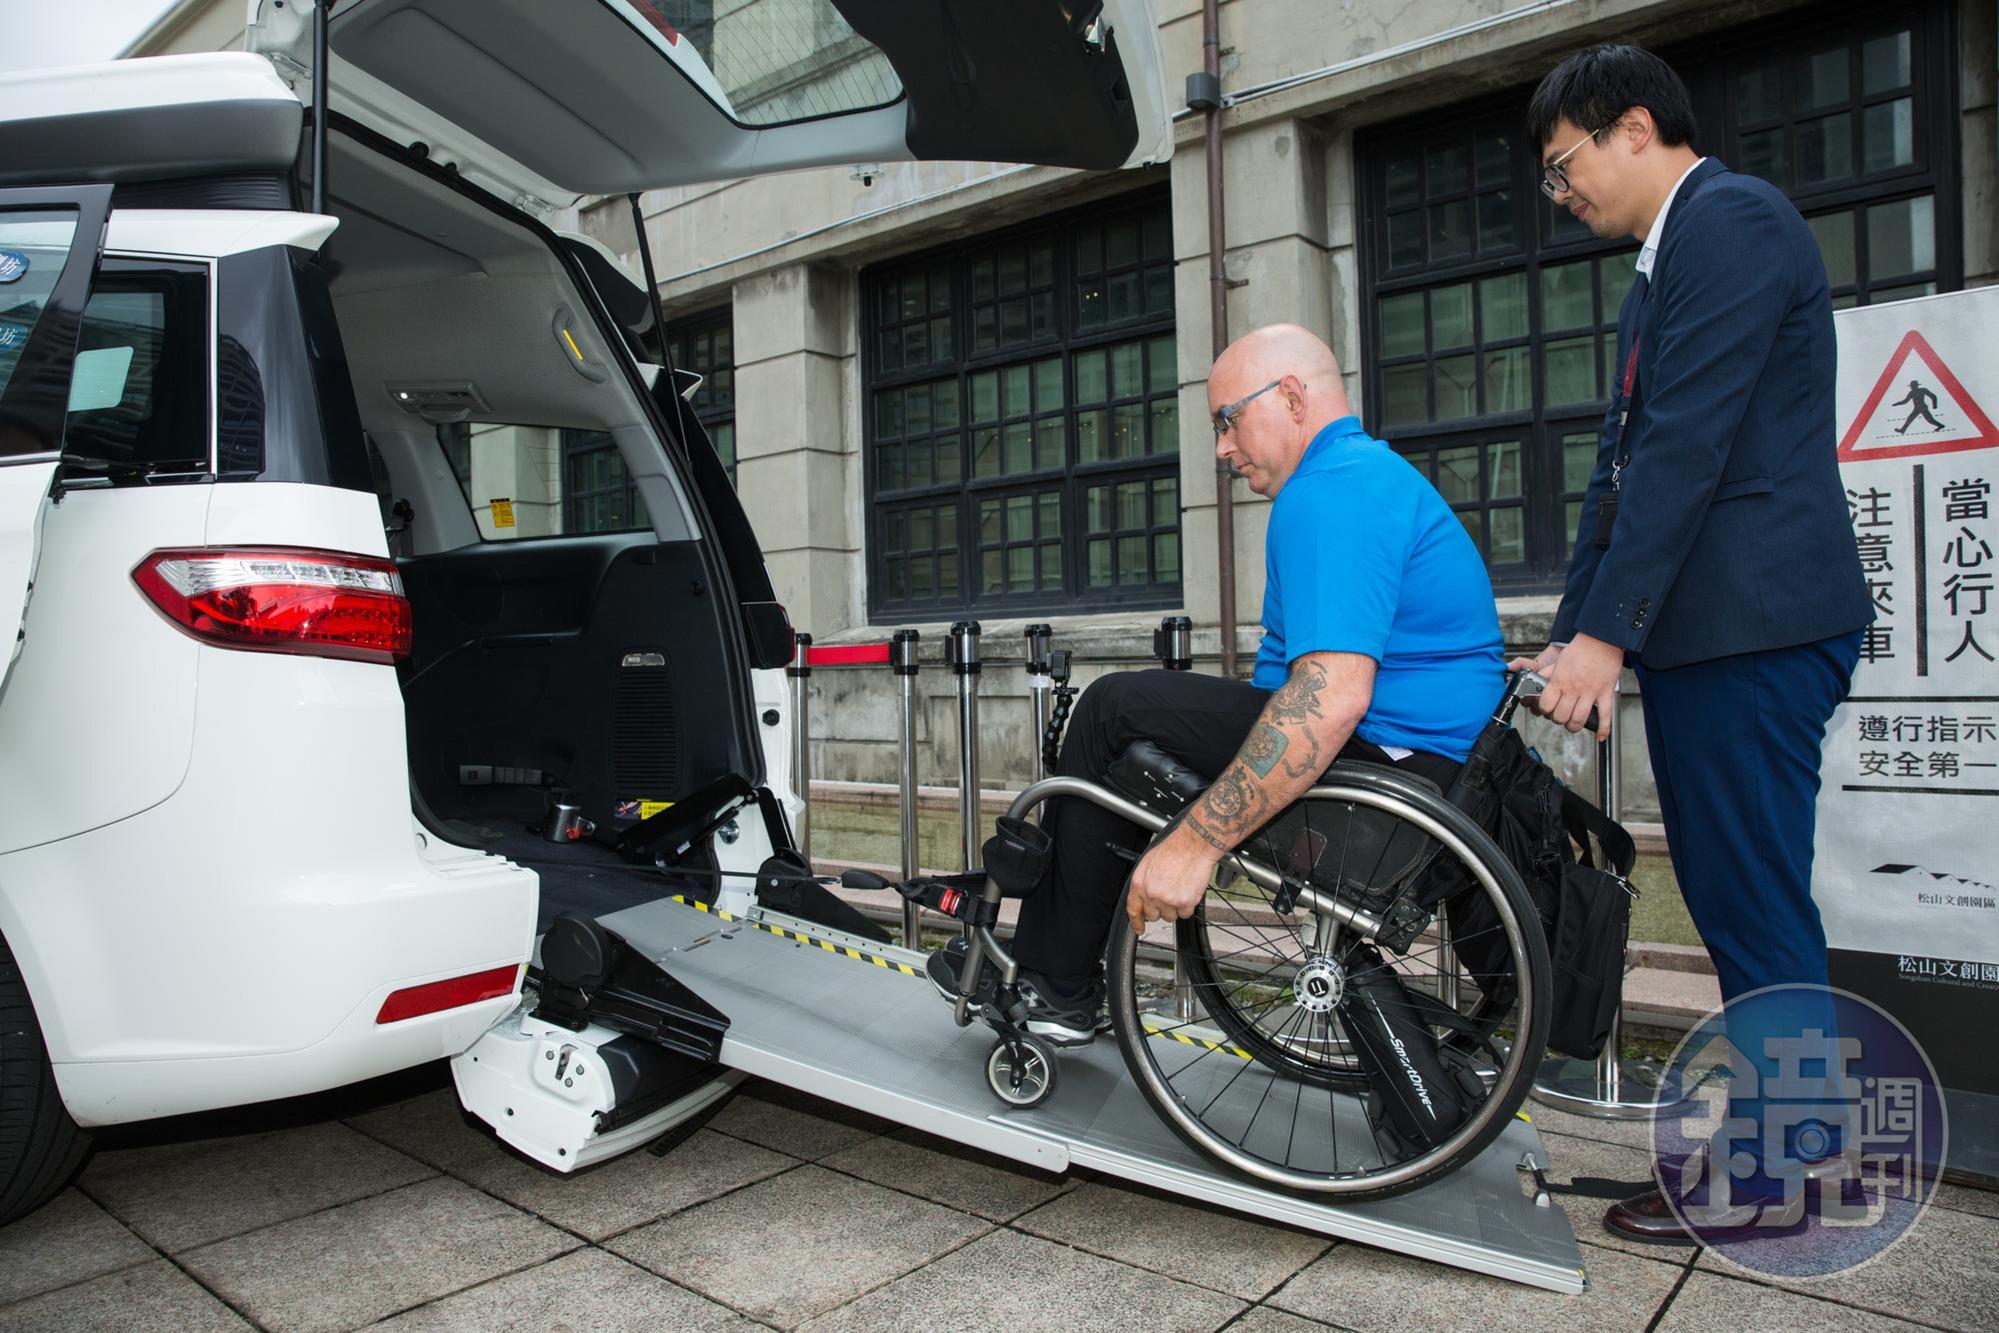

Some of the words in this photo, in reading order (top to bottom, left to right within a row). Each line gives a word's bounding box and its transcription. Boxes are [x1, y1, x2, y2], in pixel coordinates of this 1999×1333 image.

[1942, 477, 1996, 663] 當心行人
[1858, 715, 1997, 743] 遵行指示
[1859, 750, 1998, 778] 安全第一
[1917, 892, 1996, 909] 松山文創園區
[1897, 955, 1999, 982] 松山文創園
